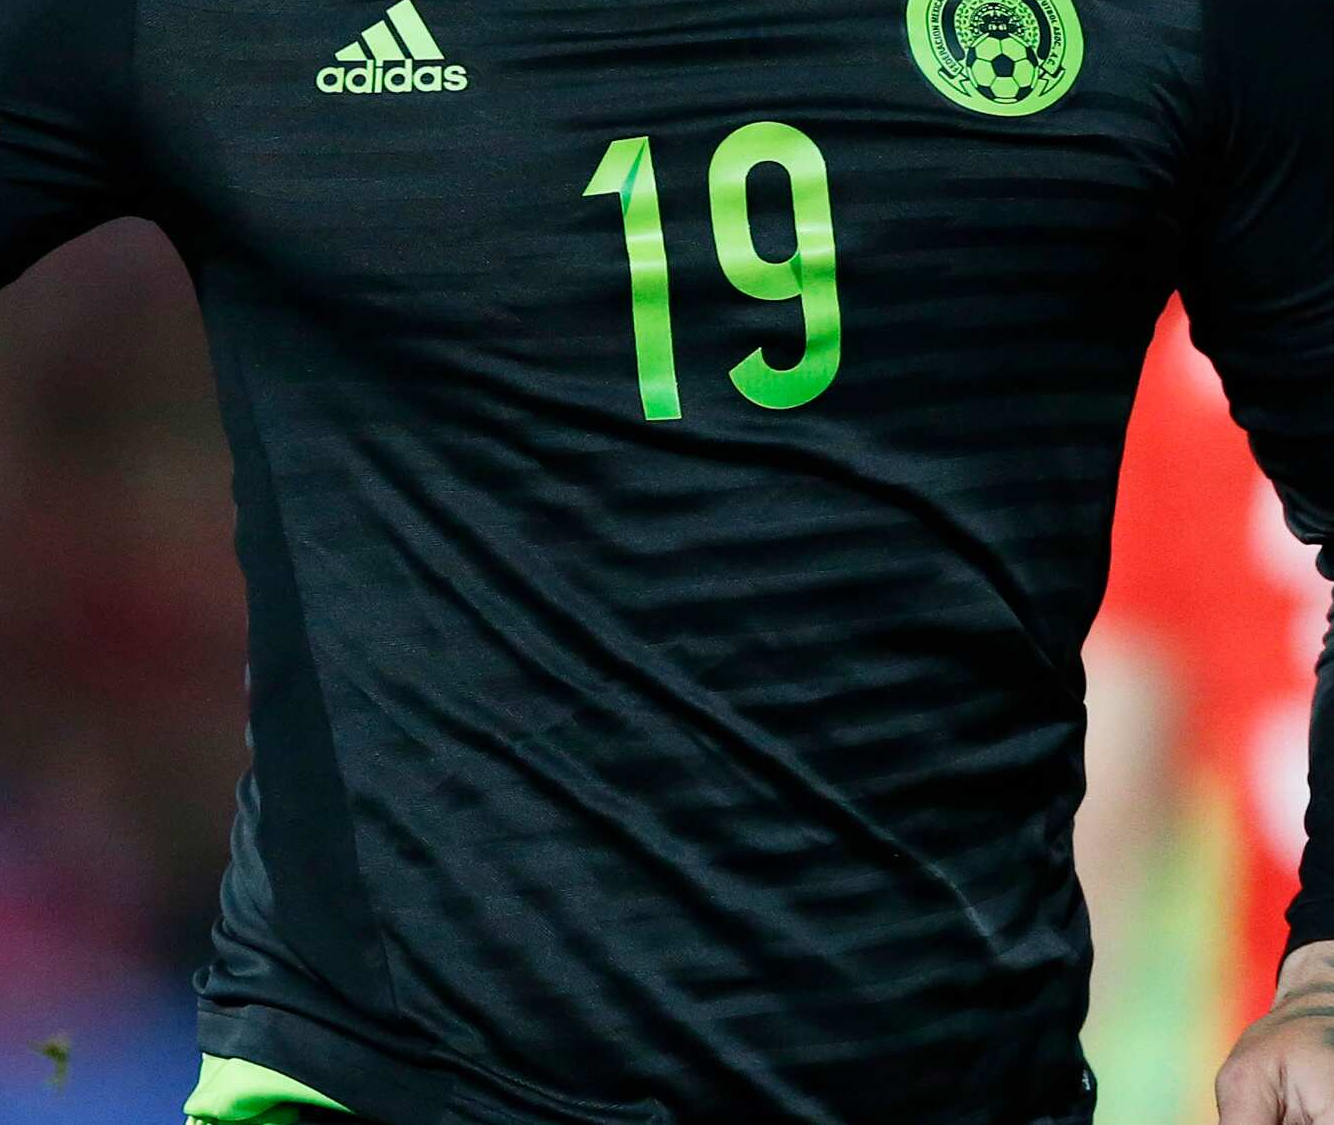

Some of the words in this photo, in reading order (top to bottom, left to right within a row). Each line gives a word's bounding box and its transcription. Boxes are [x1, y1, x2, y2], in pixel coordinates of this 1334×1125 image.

[932, 25, 960, 73] FEDERACION
[316, 59, 468, 94] adidas
[582, 121, 842, 421] 19
